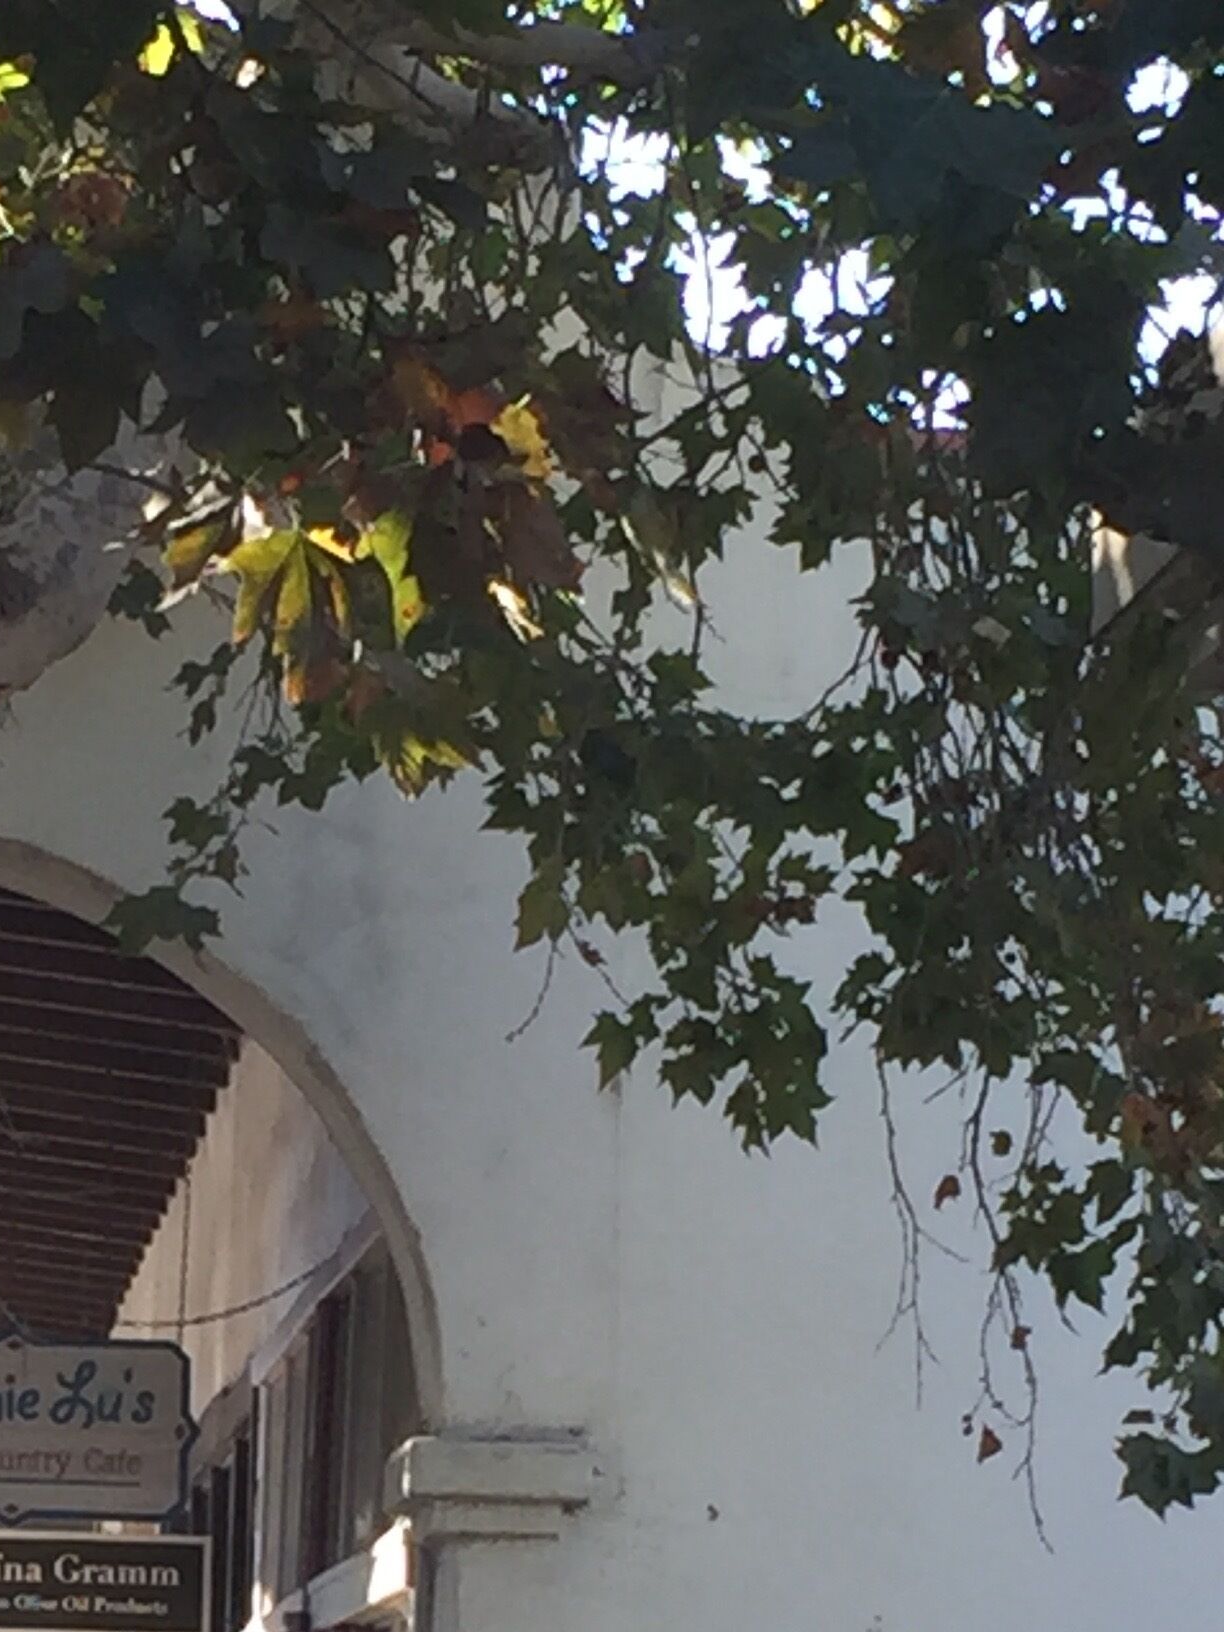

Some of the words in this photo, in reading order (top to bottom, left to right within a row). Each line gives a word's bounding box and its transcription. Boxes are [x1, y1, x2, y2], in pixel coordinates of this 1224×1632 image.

[49, 1359, 155, 1429] Lu's
[83, 1448, 142, 1475] Cafe
[53, 1554, 179, 1586] Gramm
[62, 1595, 89, 1612] Oil
[94, 1597, 169, 1616] Products
